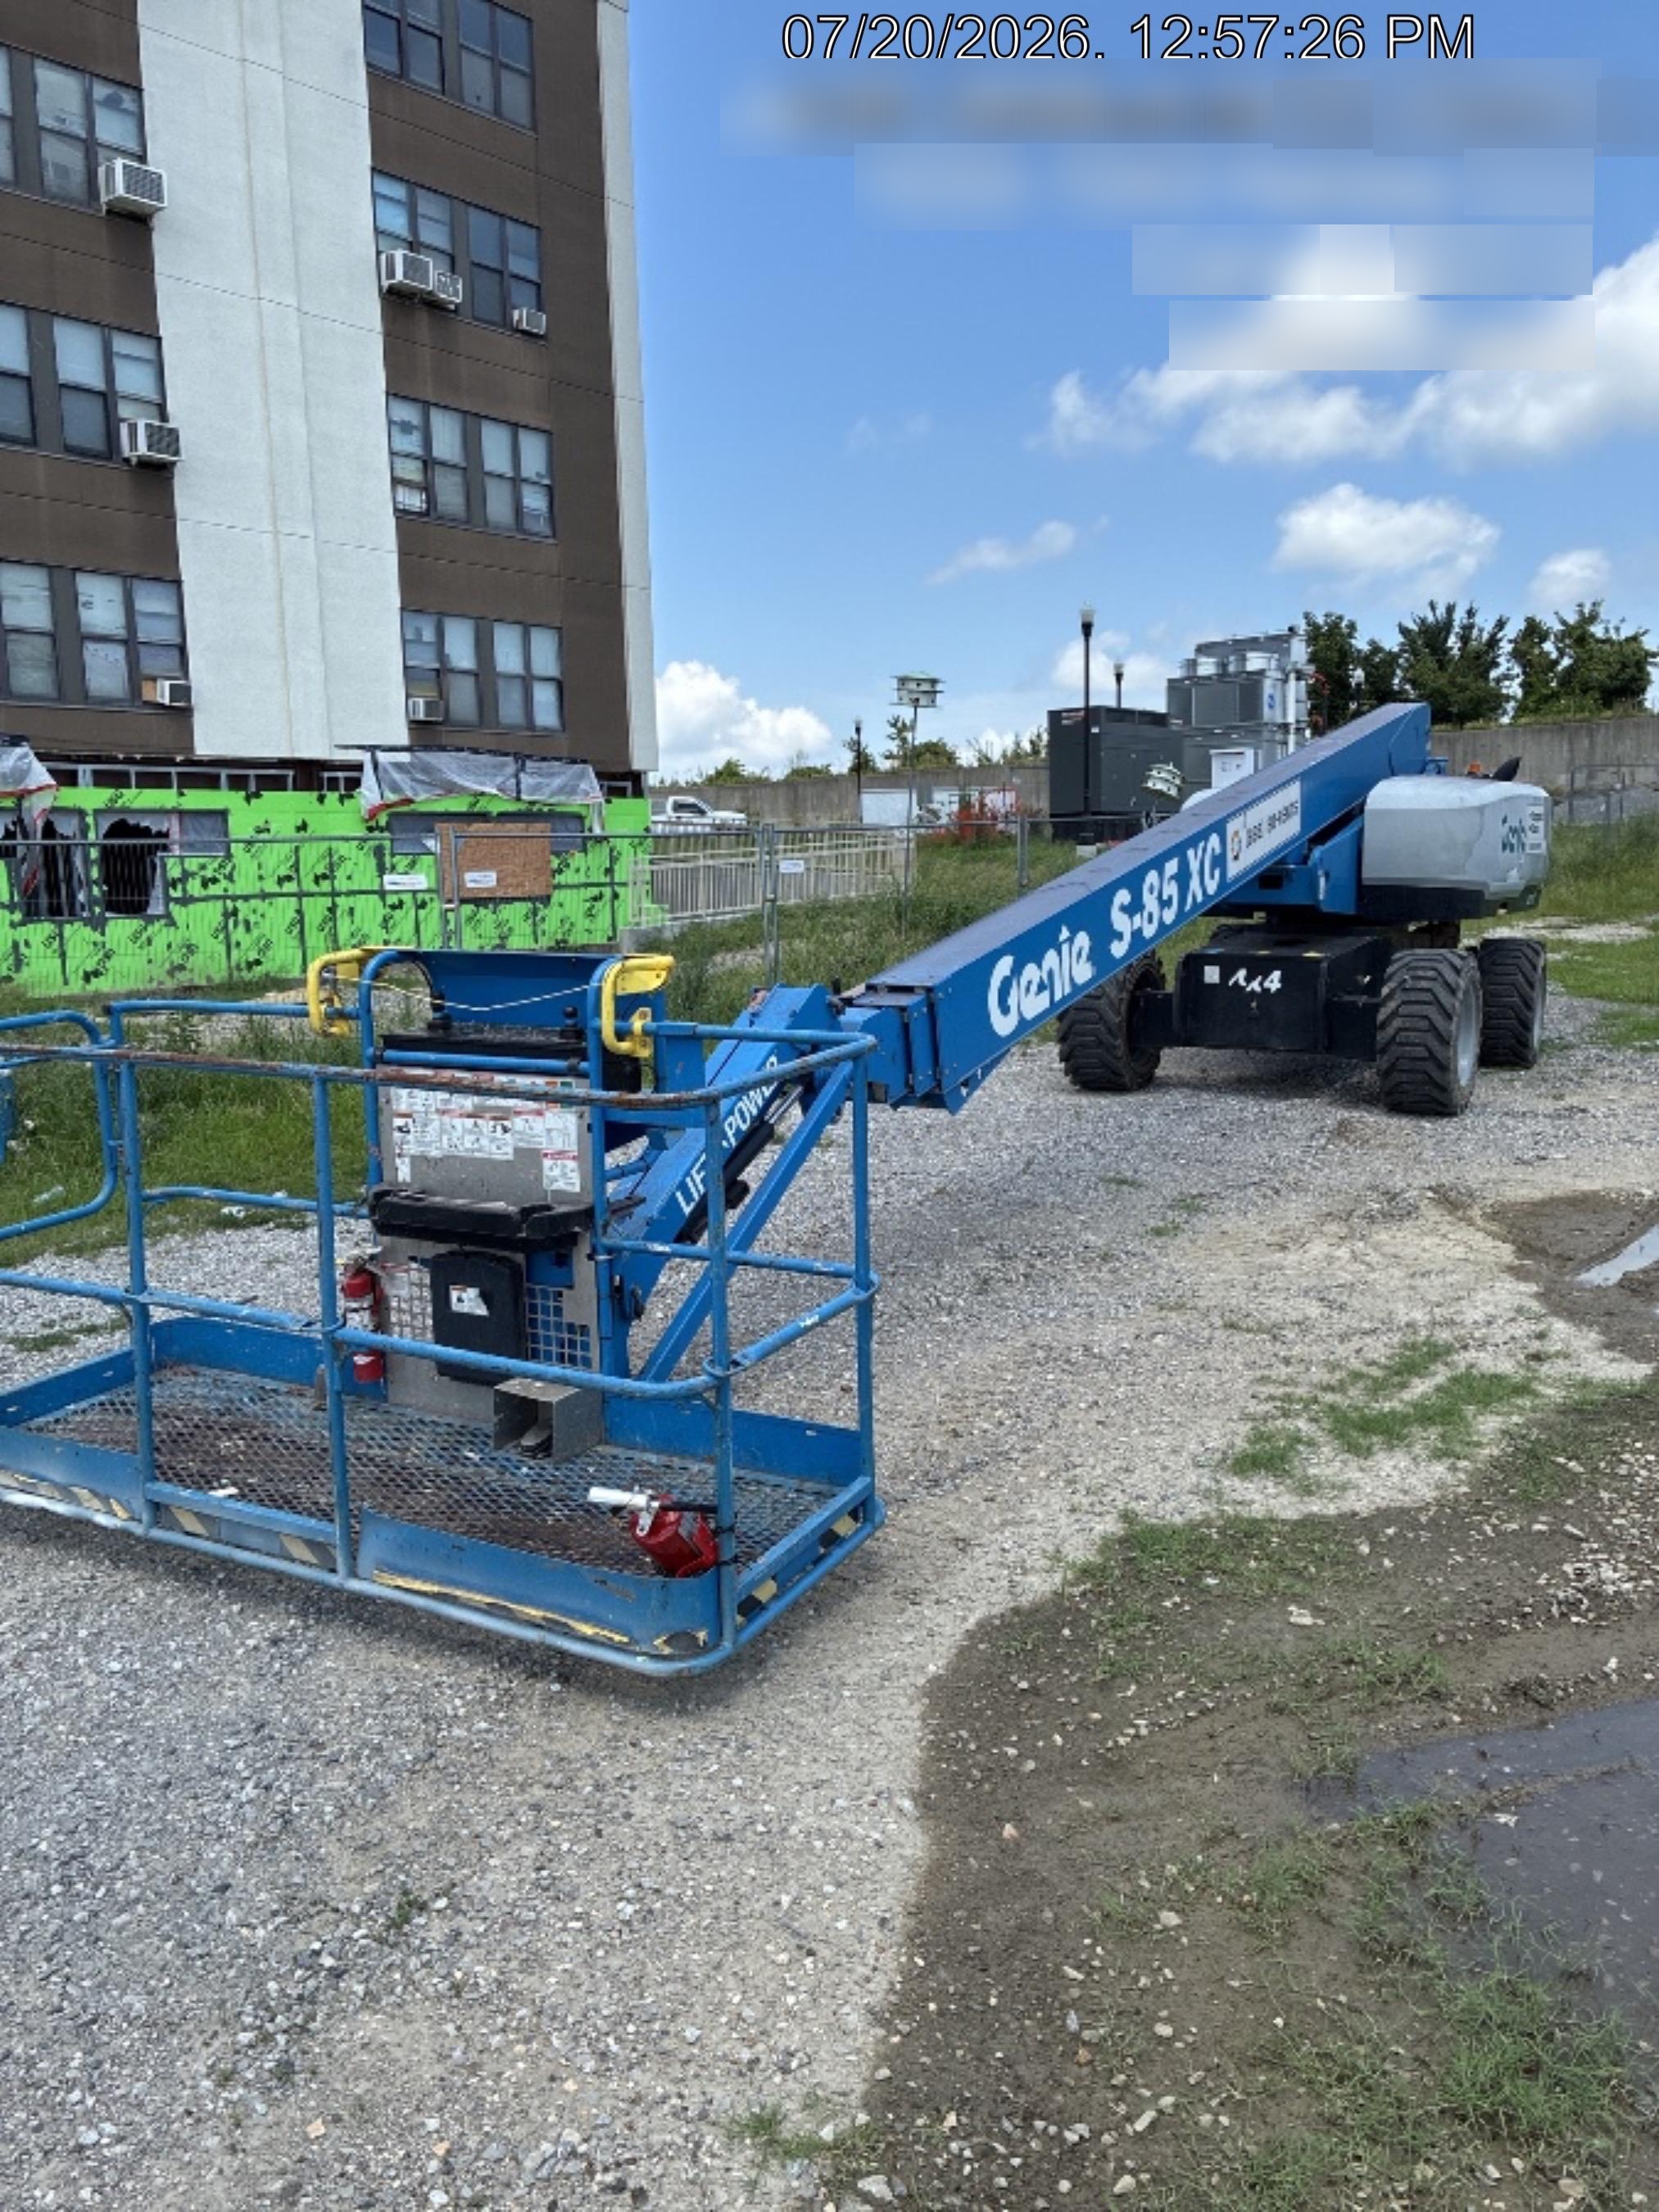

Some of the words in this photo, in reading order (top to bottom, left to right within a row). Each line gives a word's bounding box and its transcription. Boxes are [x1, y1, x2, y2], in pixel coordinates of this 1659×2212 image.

[987, 924, 1094, 1037] Genie
[1109, 857, 1179, 959] S-85
[1184, 832, 1222, 913] XC
